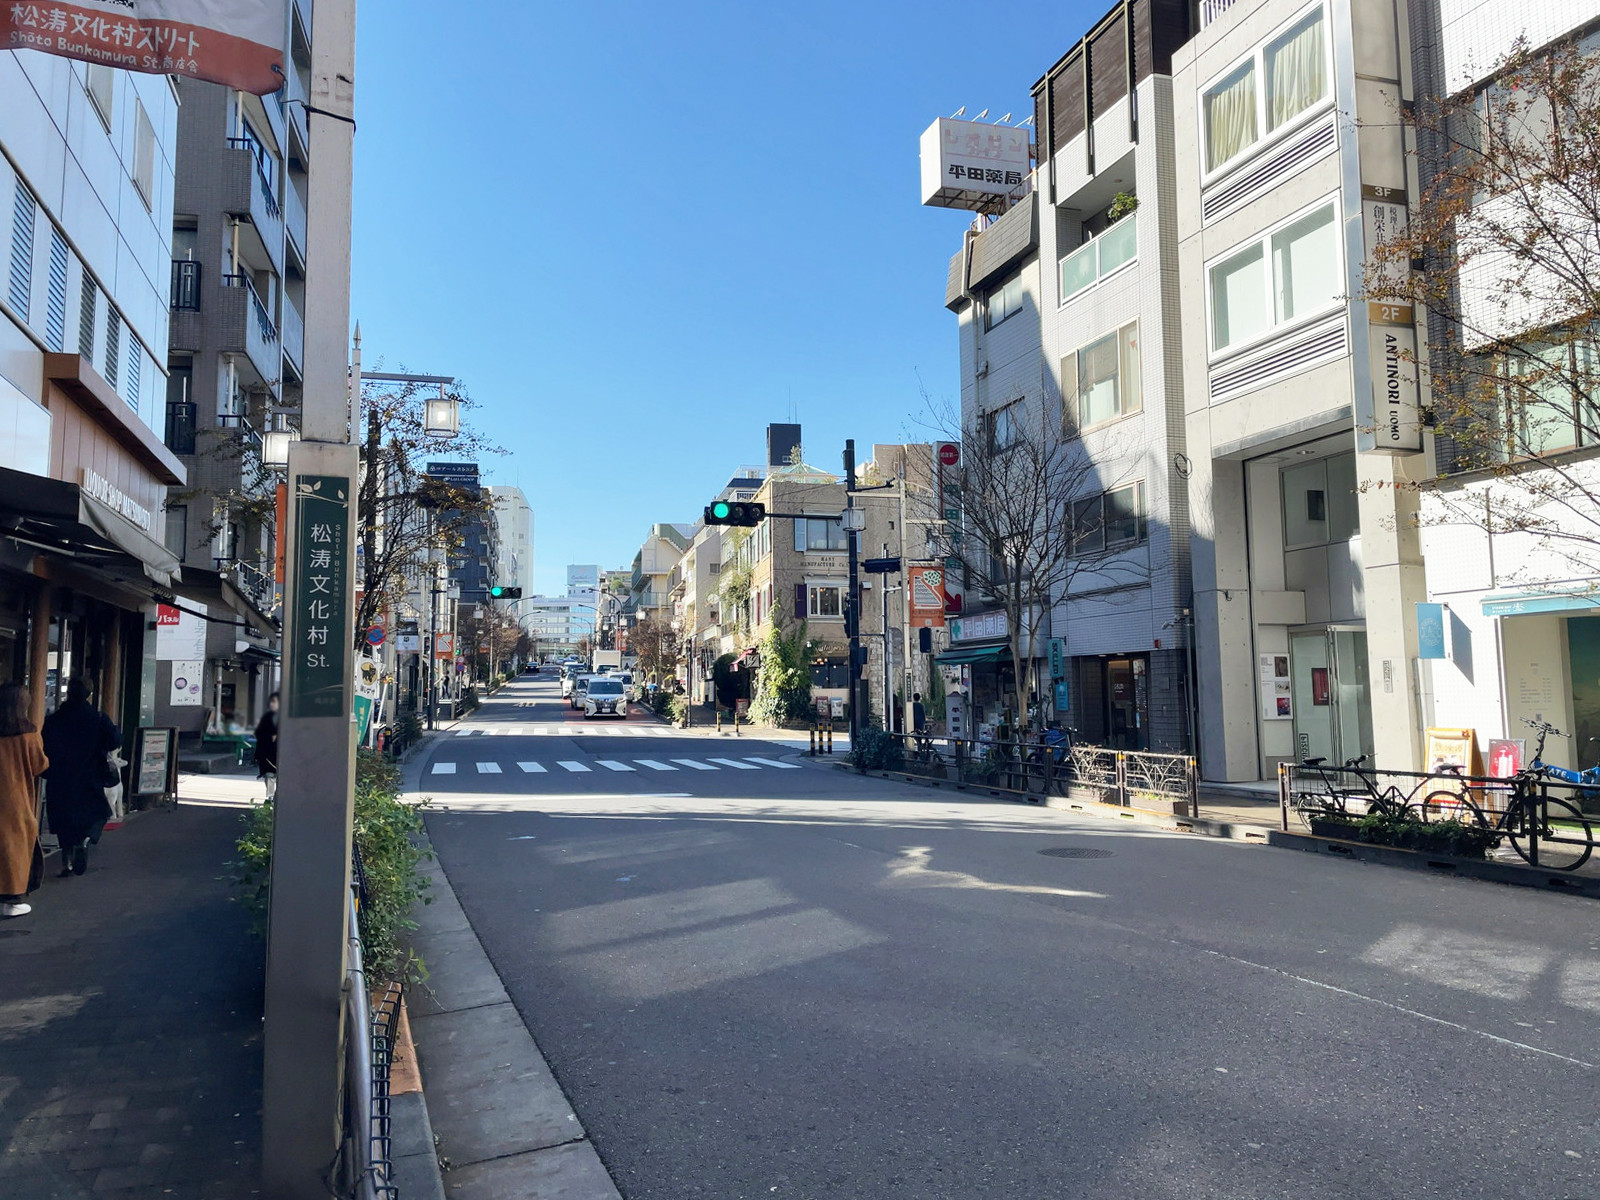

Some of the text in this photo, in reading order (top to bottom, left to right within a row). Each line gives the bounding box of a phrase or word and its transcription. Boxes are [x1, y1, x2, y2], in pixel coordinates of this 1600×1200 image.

[10, 5, 201, 57] 松涛文化村ストリート
[57, 38, 137, 66] Bunkamura
[162, 55, 199, 73] 商店会
[948, 164, 1023, 186] 平田薬局
[1375, 186, 1391, 198] 3F
[1381, 306, 1400, 321] 2F
[1385, 333, 1400, 441] ANTINORI UOMO
[86, 467, 108, 503] LIQUOR
[108, 484, 123, 513] SHOP
[306, 522, 332, 646] 松涛文化村
[306, 653, 331, 668] St.
[1549, 767, 1570, 779] ATE.
